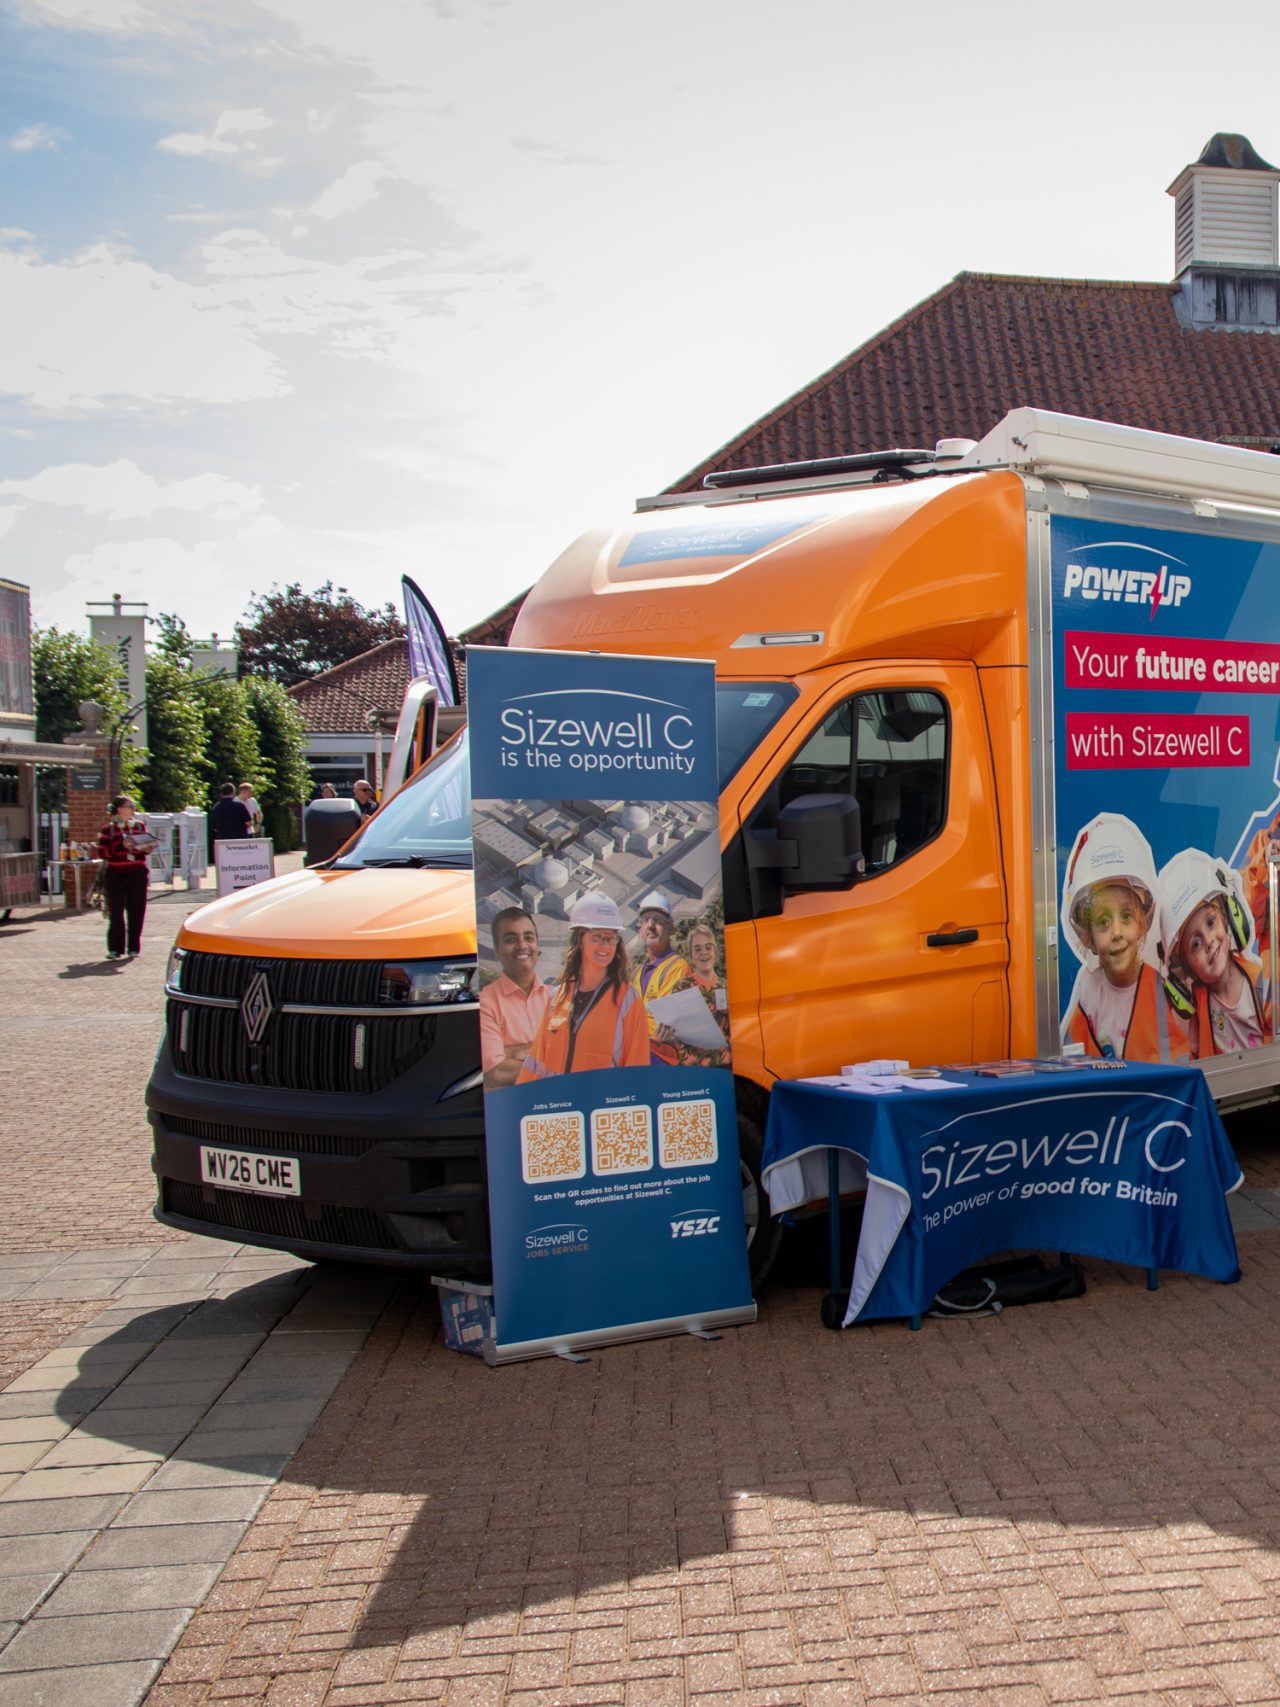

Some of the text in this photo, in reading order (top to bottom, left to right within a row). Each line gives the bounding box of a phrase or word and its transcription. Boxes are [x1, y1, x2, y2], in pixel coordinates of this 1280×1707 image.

[1072, 645, 1280, 684] Your future career
[500, 708, 695, 750] Sizewell C
[1071, 725, 1243, 757] with Sizewell C
[501, 748, 695, 774] is the opportunity
[532, 1101, 572, 1111] Jobs Service
[661, 1091, 681, 1099] Young
[681, 1089, 704, 1097] Sizewell
[207, 1151, 293, 1189] WV26 CME
[921, 1116, 1192, 1200] Sizewell C
[534, 1174, 711, 1202] Scan the QR codes to find out more about the job
[575, 1187, 673, 1208] opportunities at Sizewell C.
[943, 1191, 994, 1227] power
[998, 1182, 1020, 1201] of
[1020, 1177, 1075, 1200] good
[1080, 1176, 1112, 1196] for
[1116, 1180, 1178, 1208] Britain
[525, 1228, 589, 1249] Sizewell C
[670, 1216, 721, 1239] YSZC
[525, 1243, 589, 1259] JOBS SERVICE
